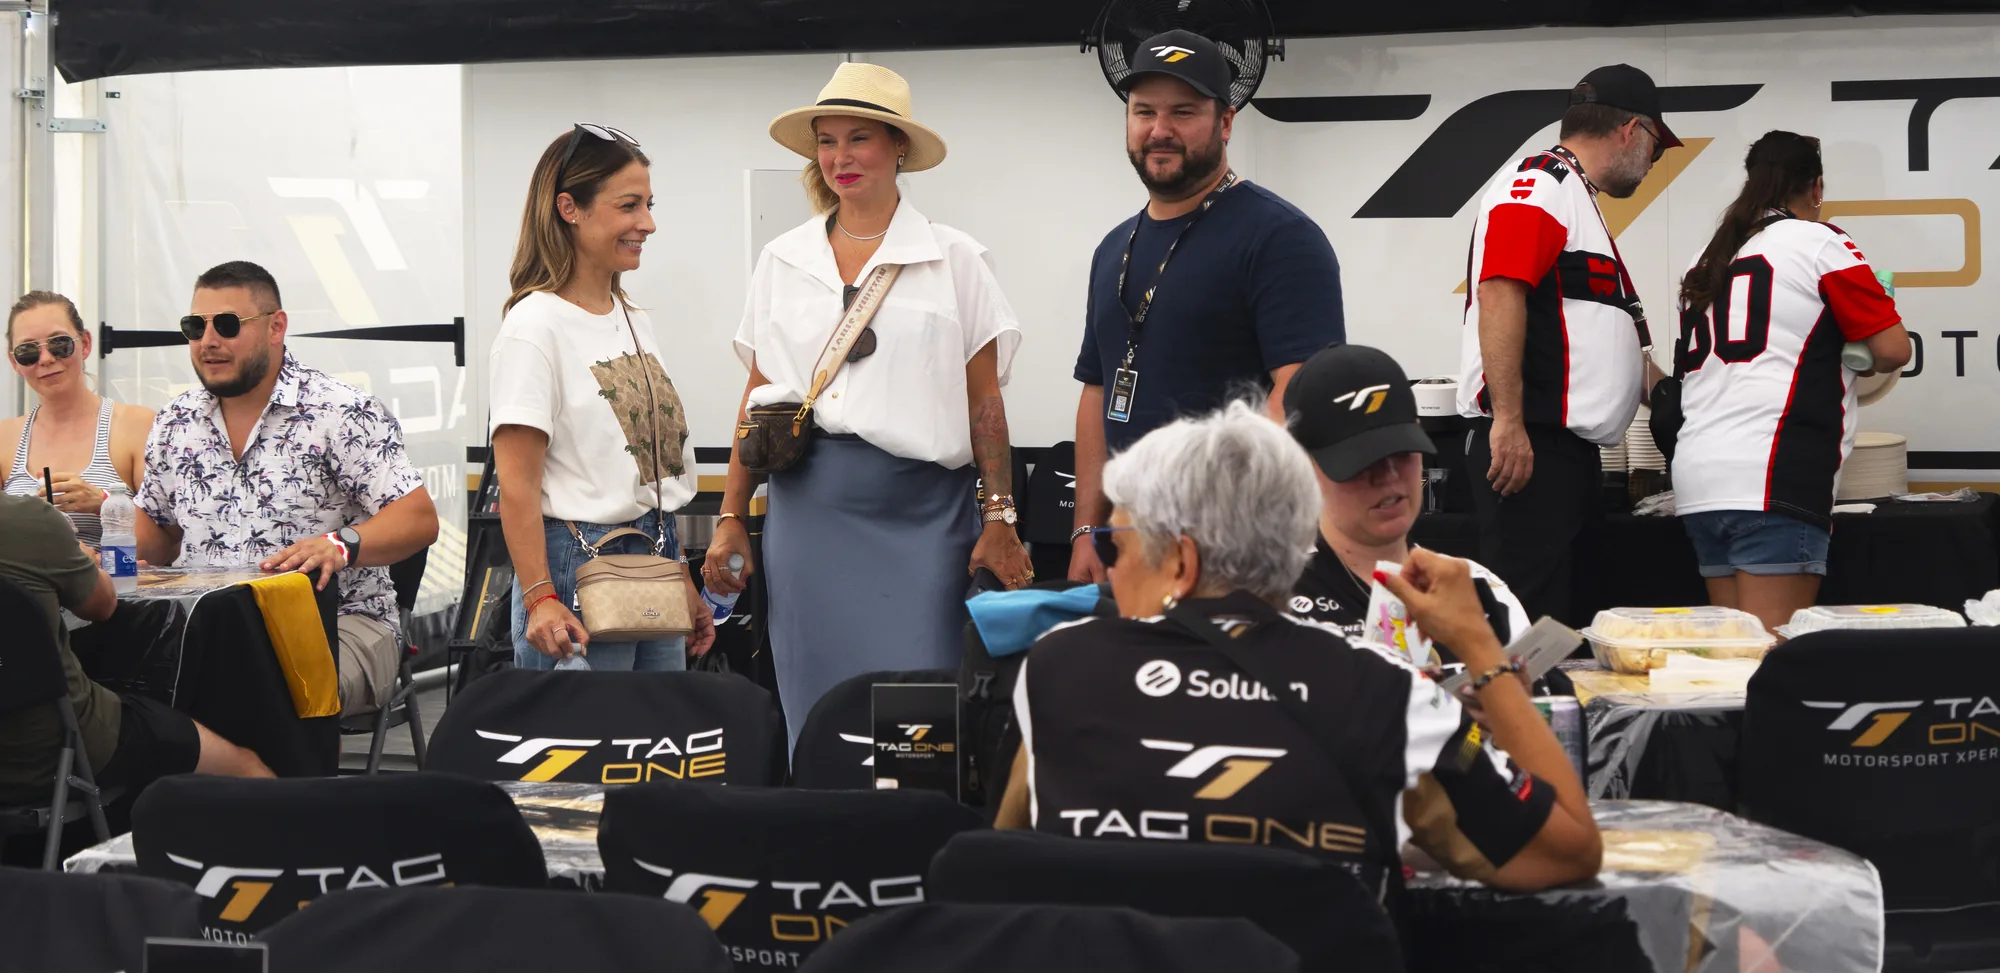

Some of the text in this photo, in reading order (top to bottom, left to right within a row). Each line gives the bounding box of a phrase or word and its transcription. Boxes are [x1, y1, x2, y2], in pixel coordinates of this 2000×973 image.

[611, 728, 723, 760] TAG
[876, 742, 955, 752] TAG ONE
[1823, 752, 1950, 767] MOTORSPORT
[601, 752, 726, 784] ONE
[1060, 808, 1367, 853] TAG ONE
[296, 853, 446, 894] TAG
[771, 875, 924, 910] TAG
